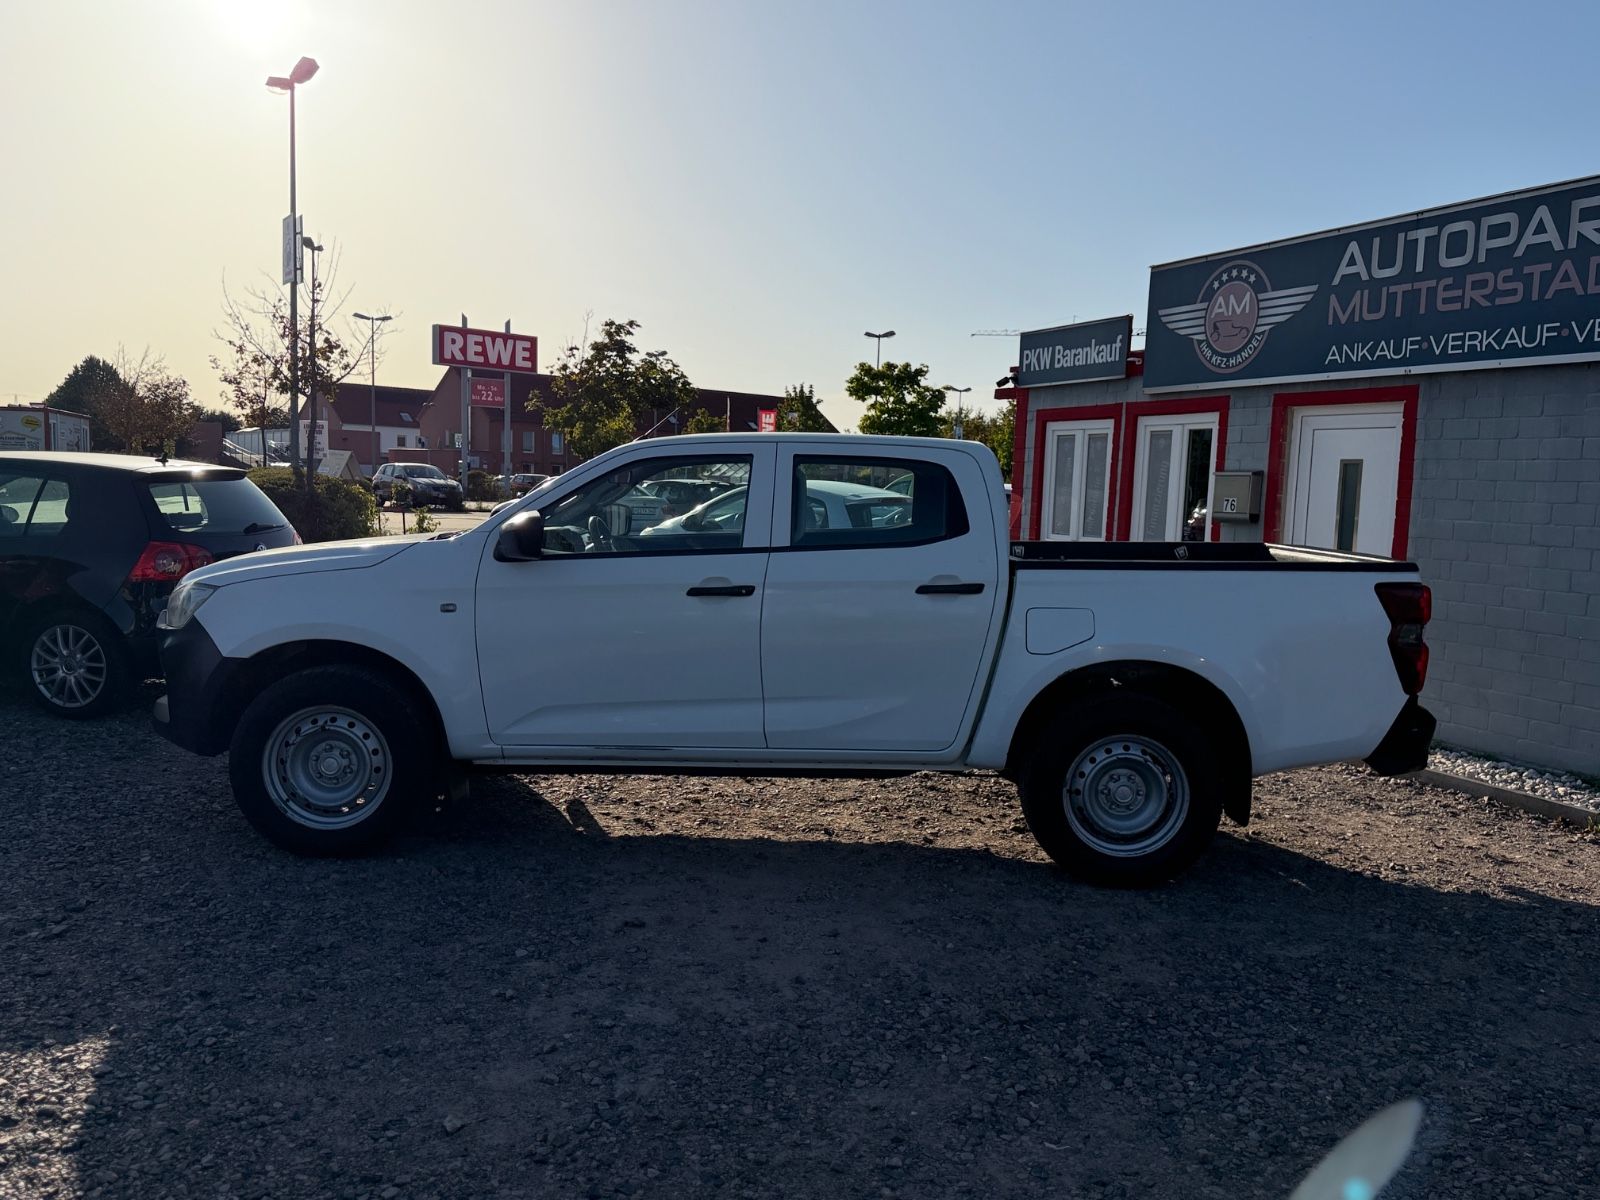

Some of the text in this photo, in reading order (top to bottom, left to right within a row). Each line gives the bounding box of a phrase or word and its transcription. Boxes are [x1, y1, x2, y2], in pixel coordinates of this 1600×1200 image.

[1331, 195, 1600, 286] AUTOPAR
[1211, 291, 1251, 318] AM
[443, 331, 532, 368] REWE
[1023, 334, 1123, 372] PKW Barankauf
[1200, 334, 1264, 368] IHR KFZ-HANDEL
[1325, 336, 1421, 365] ANKAUF
[1430, 323, 1560, 355] VERKAUF
[481, 391, 493, 401] 22
[1224, 498, 1236, 511] 76
